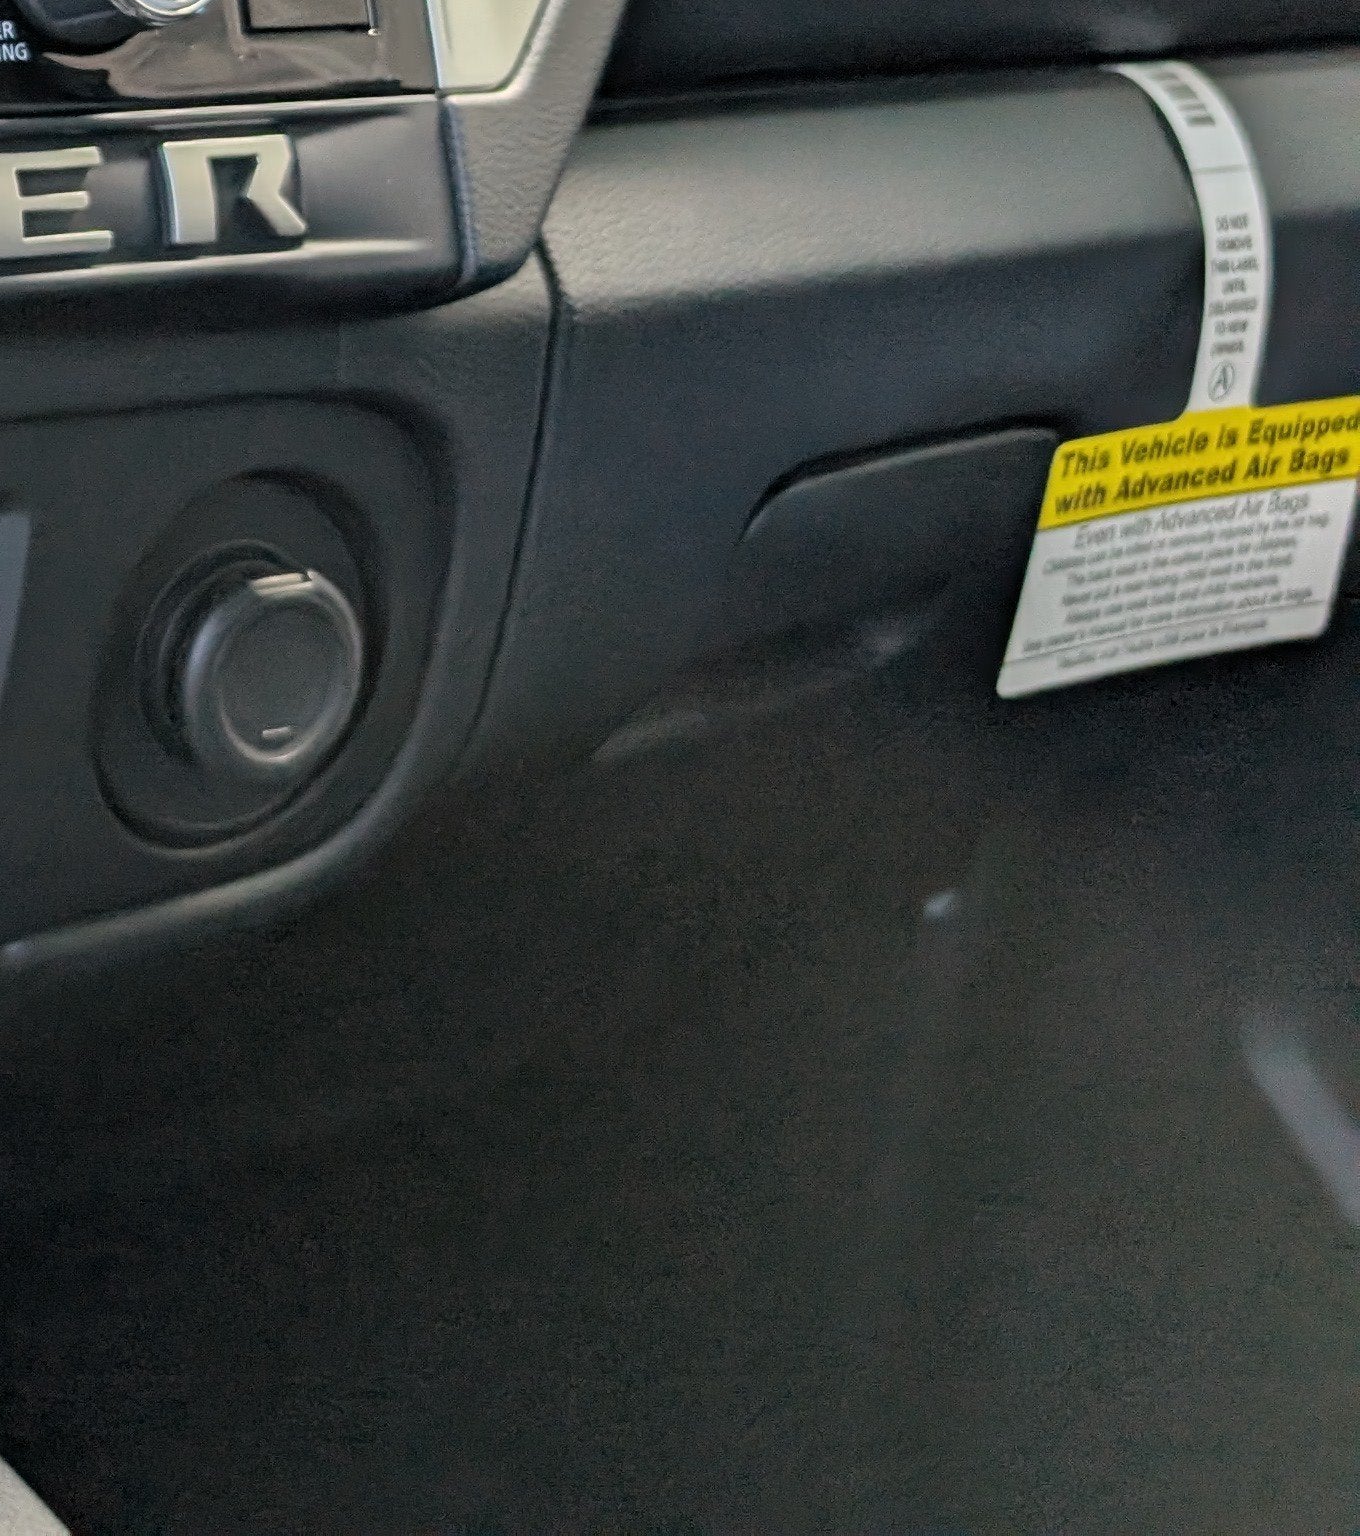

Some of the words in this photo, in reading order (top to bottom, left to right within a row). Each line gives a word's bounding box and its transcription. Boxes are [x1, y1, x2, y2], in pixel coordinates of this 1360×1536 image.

[1054, 480, 1108, 516] with
[1113, 458, 1237, 502] Advanced
[1242, 451, 1283, 480] Air
[1288, 445, 1351, 474] Bags
[1060, 447, 1111, 479] This
[1119, 431, 1209, 465] Vehicle
[1216, 424, 1240, 449] is
